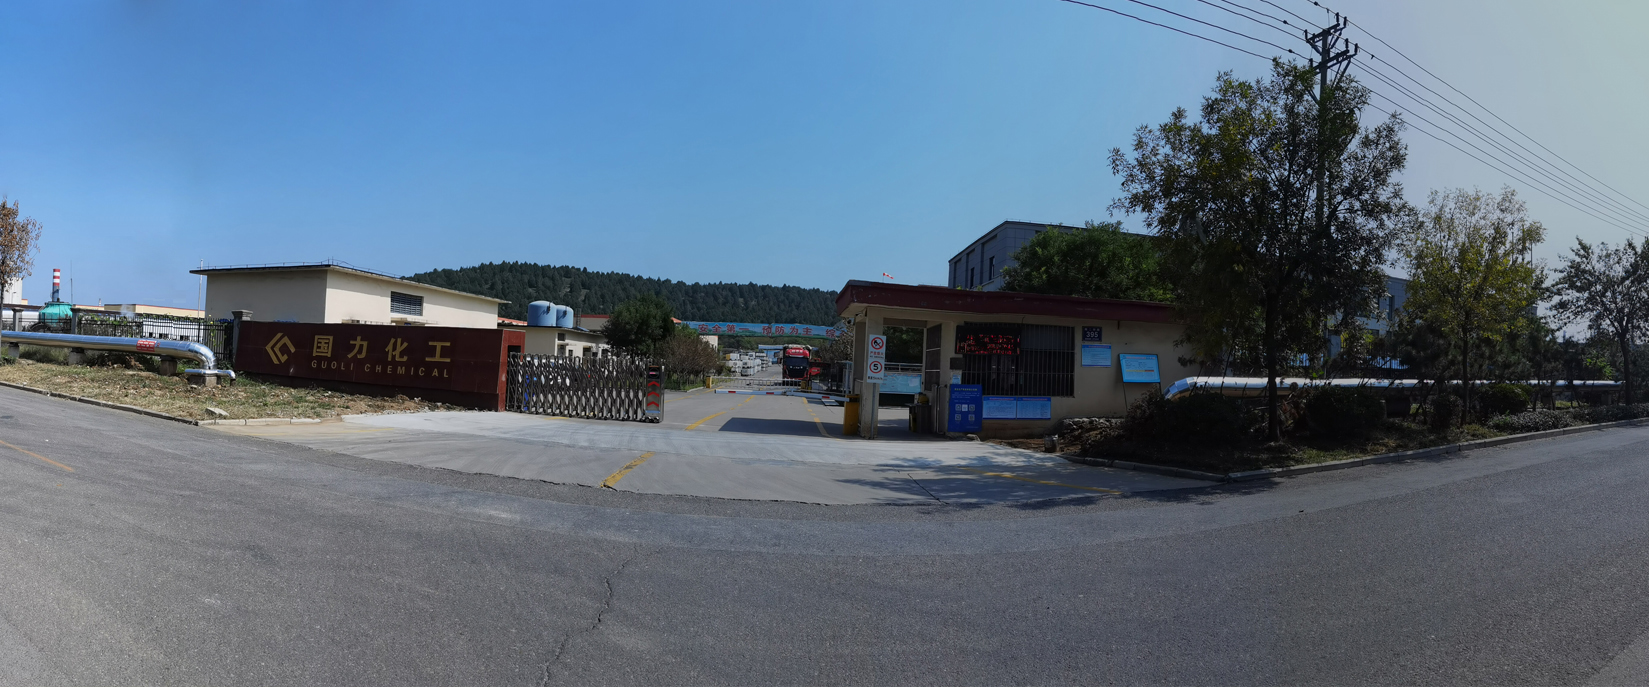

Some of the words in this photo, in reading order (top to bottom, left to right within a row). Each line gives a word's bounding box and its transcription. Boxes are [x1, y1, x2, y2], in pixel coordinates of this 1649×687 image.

[698, 323, 750, 334] 安全第一
[762, 325, 813, 337] 预防为主
[312, 335, 451, 363] 国力化工
[311, 359, 354, 371] GUOLI
[364, 363, 449, 378] CHEMICAL
[873, 363, 879, 371] 5
